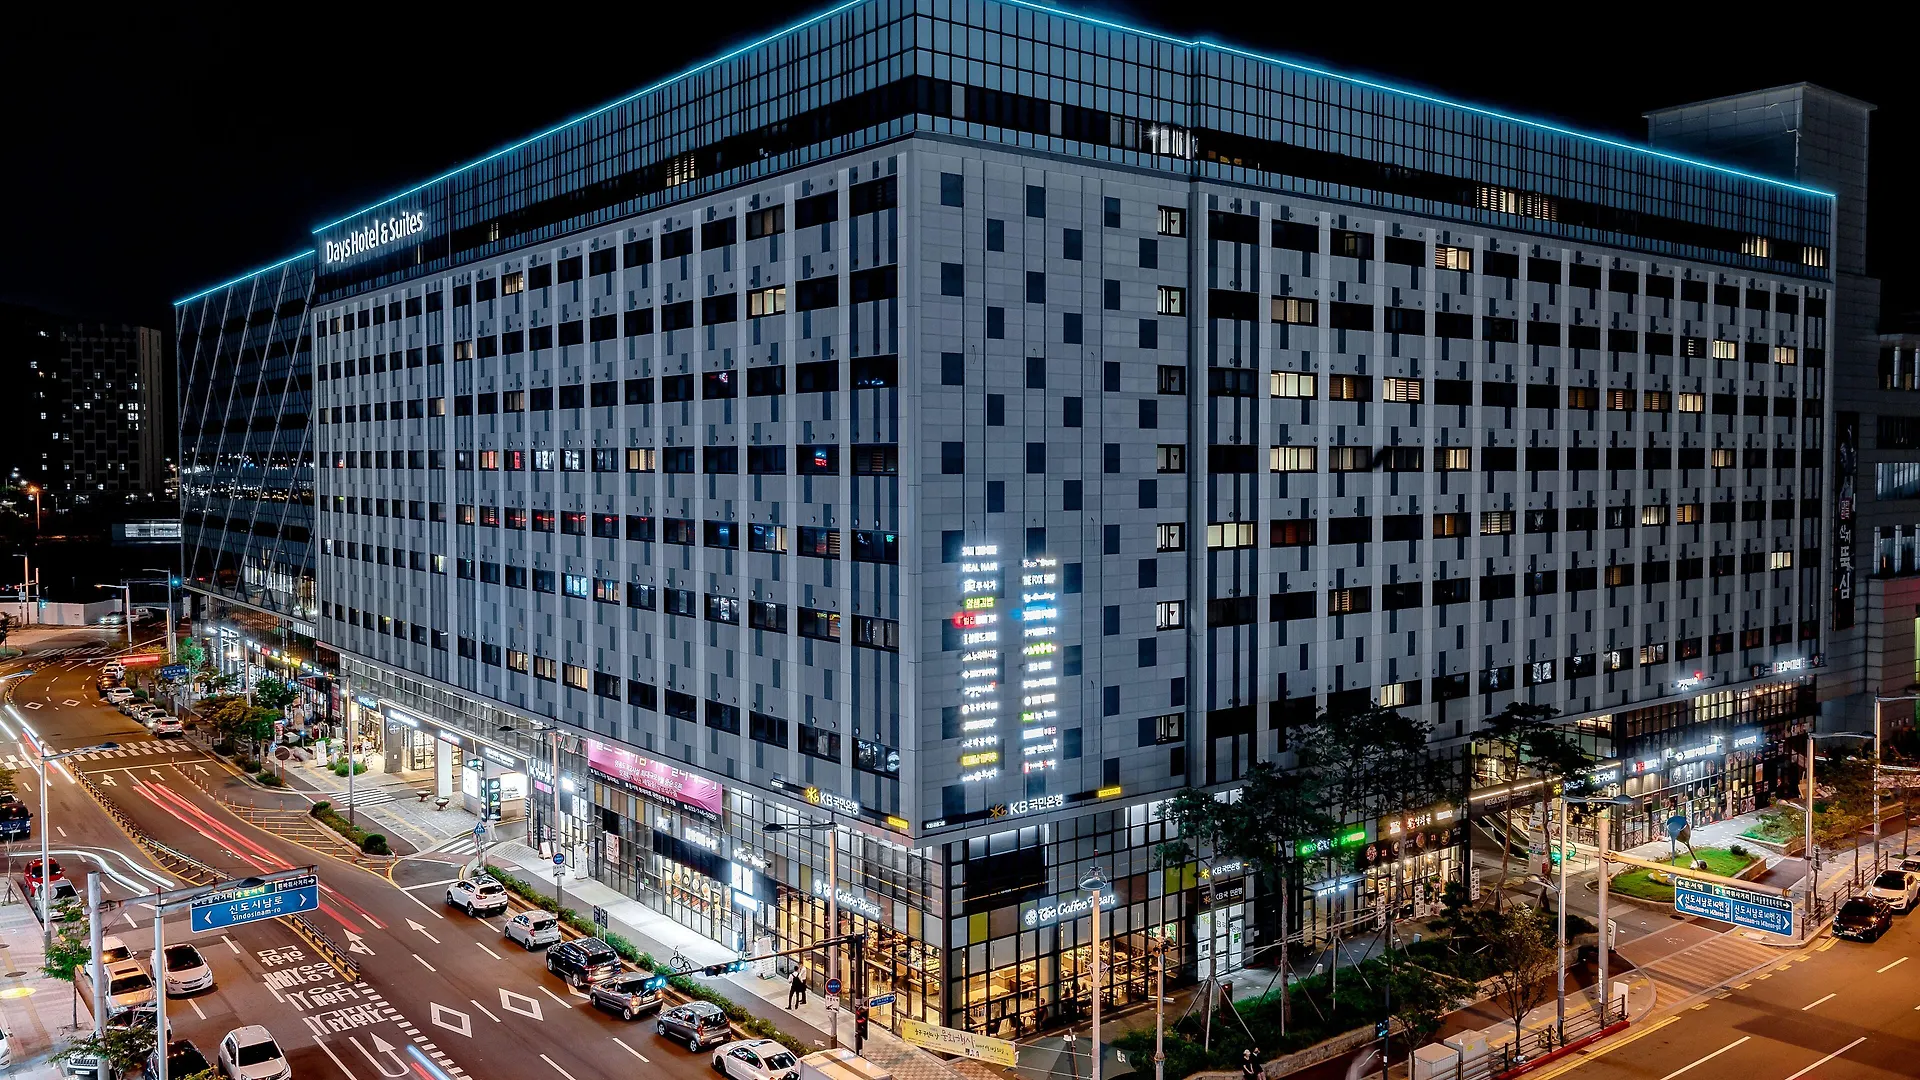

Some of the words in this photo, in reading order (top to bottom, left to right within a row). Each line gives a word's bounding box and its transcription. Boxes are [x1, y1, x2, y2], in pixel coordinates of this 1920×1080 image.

[326, 238, 350, 264] Days
[351, 219, 379, 255] Hotel
[381, 222, 389, 245] &
[389, 211, 423, 242] Suites
[820, 791, 860, 815] KB국민은행
[1010, 793, 1064, 816] KB국민은행
[229, 895, 284, 914] 신도시남로
[232, 907, 281, 922] Sindosinam-ro
[835, 888, 858, 907] Coffee
[859, 899, 880, 919] Bean
[1038, 904, 1056, 921] The
[1057, 898, 1087, 915] Coffee
[285, 981, 360, 1012] 보행시
[302, 1002, 388, 1037] 좌회전시
